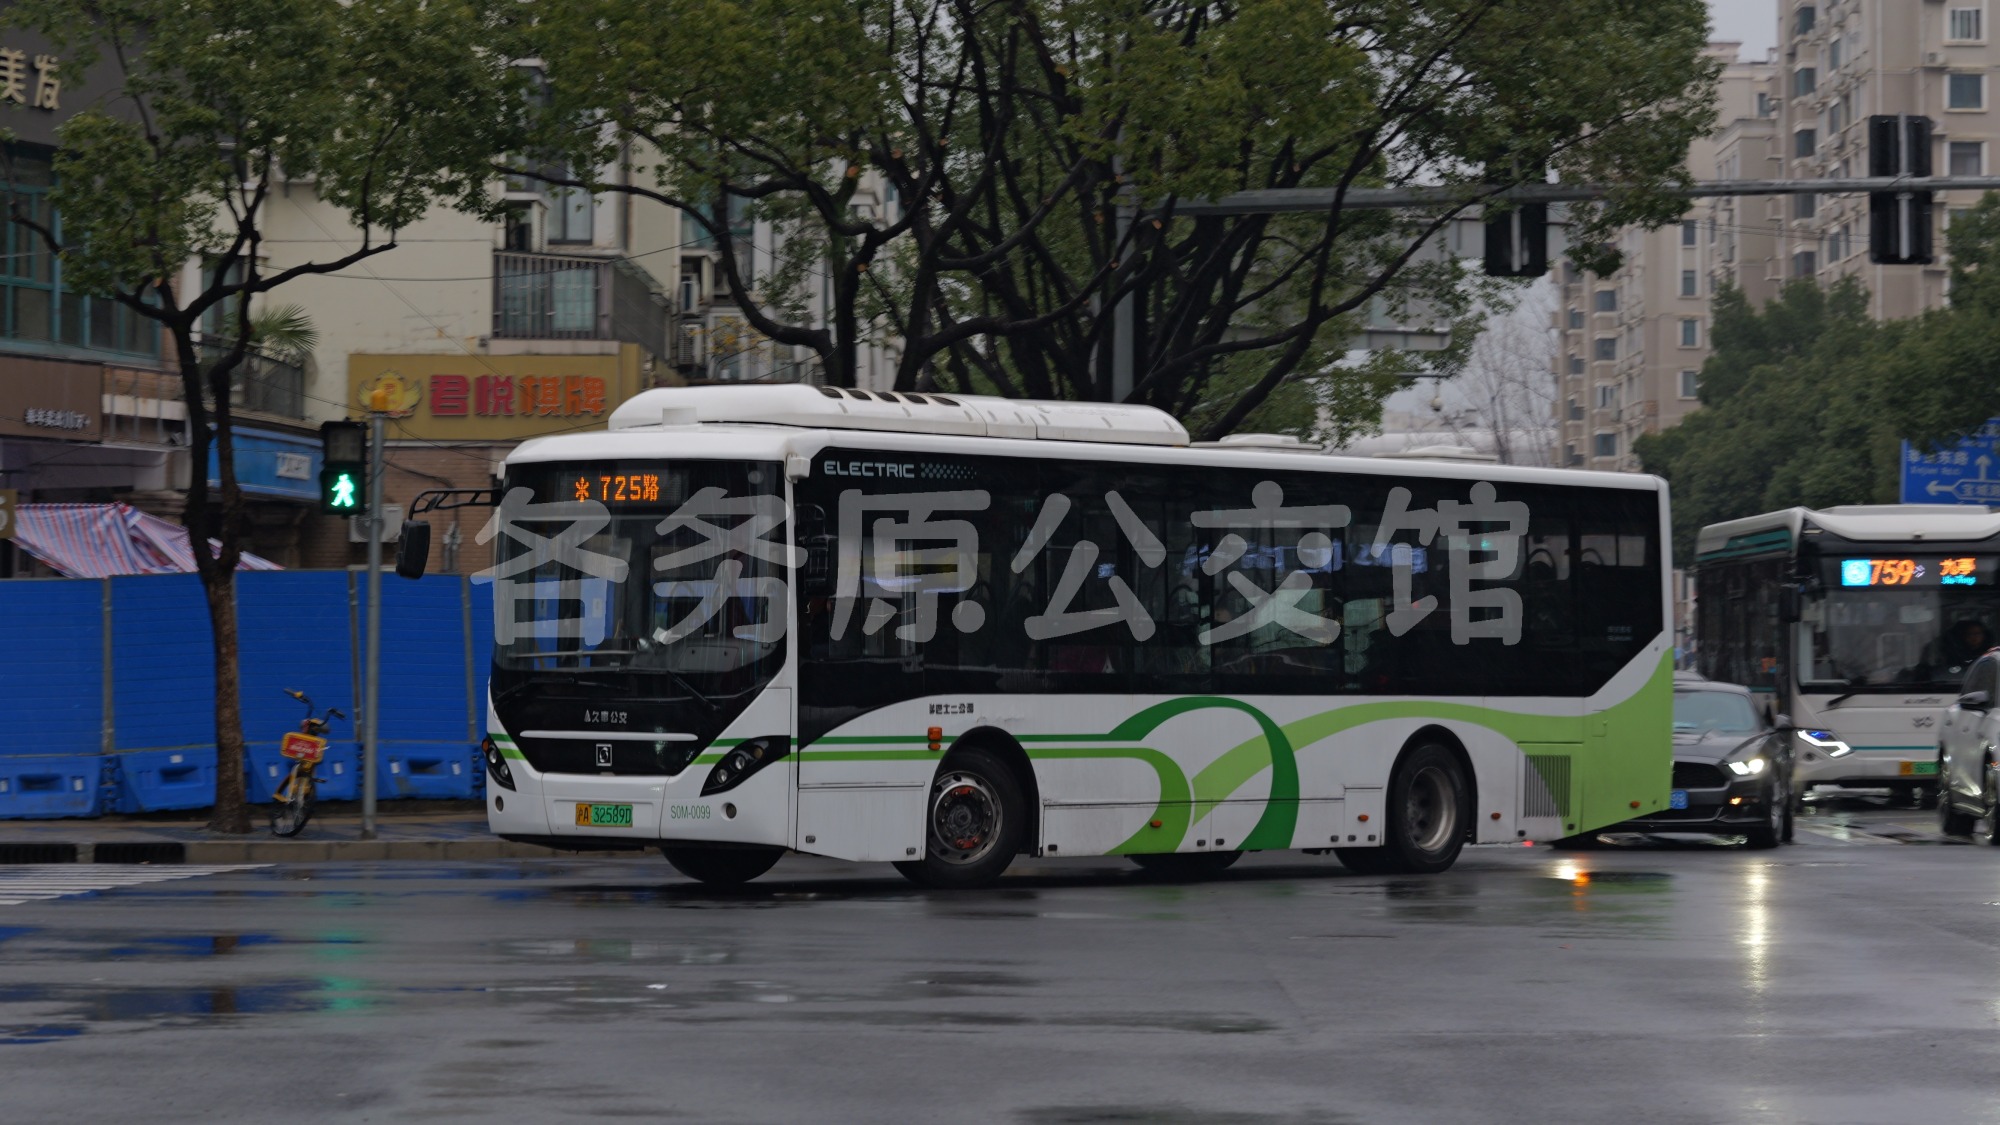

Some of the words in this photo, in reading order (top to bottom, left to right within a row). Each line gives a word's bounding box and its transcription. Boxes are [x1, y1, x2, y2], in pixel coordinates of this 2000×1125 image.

[0, 47, 60, 109] 美发
[430, 374, 606, 417] 君悦棋牌
[823, 460, 915, 479] ELECTRIC
[600, 474, 659, 501] 725路
[1869, 559, 1916, 586] 759
